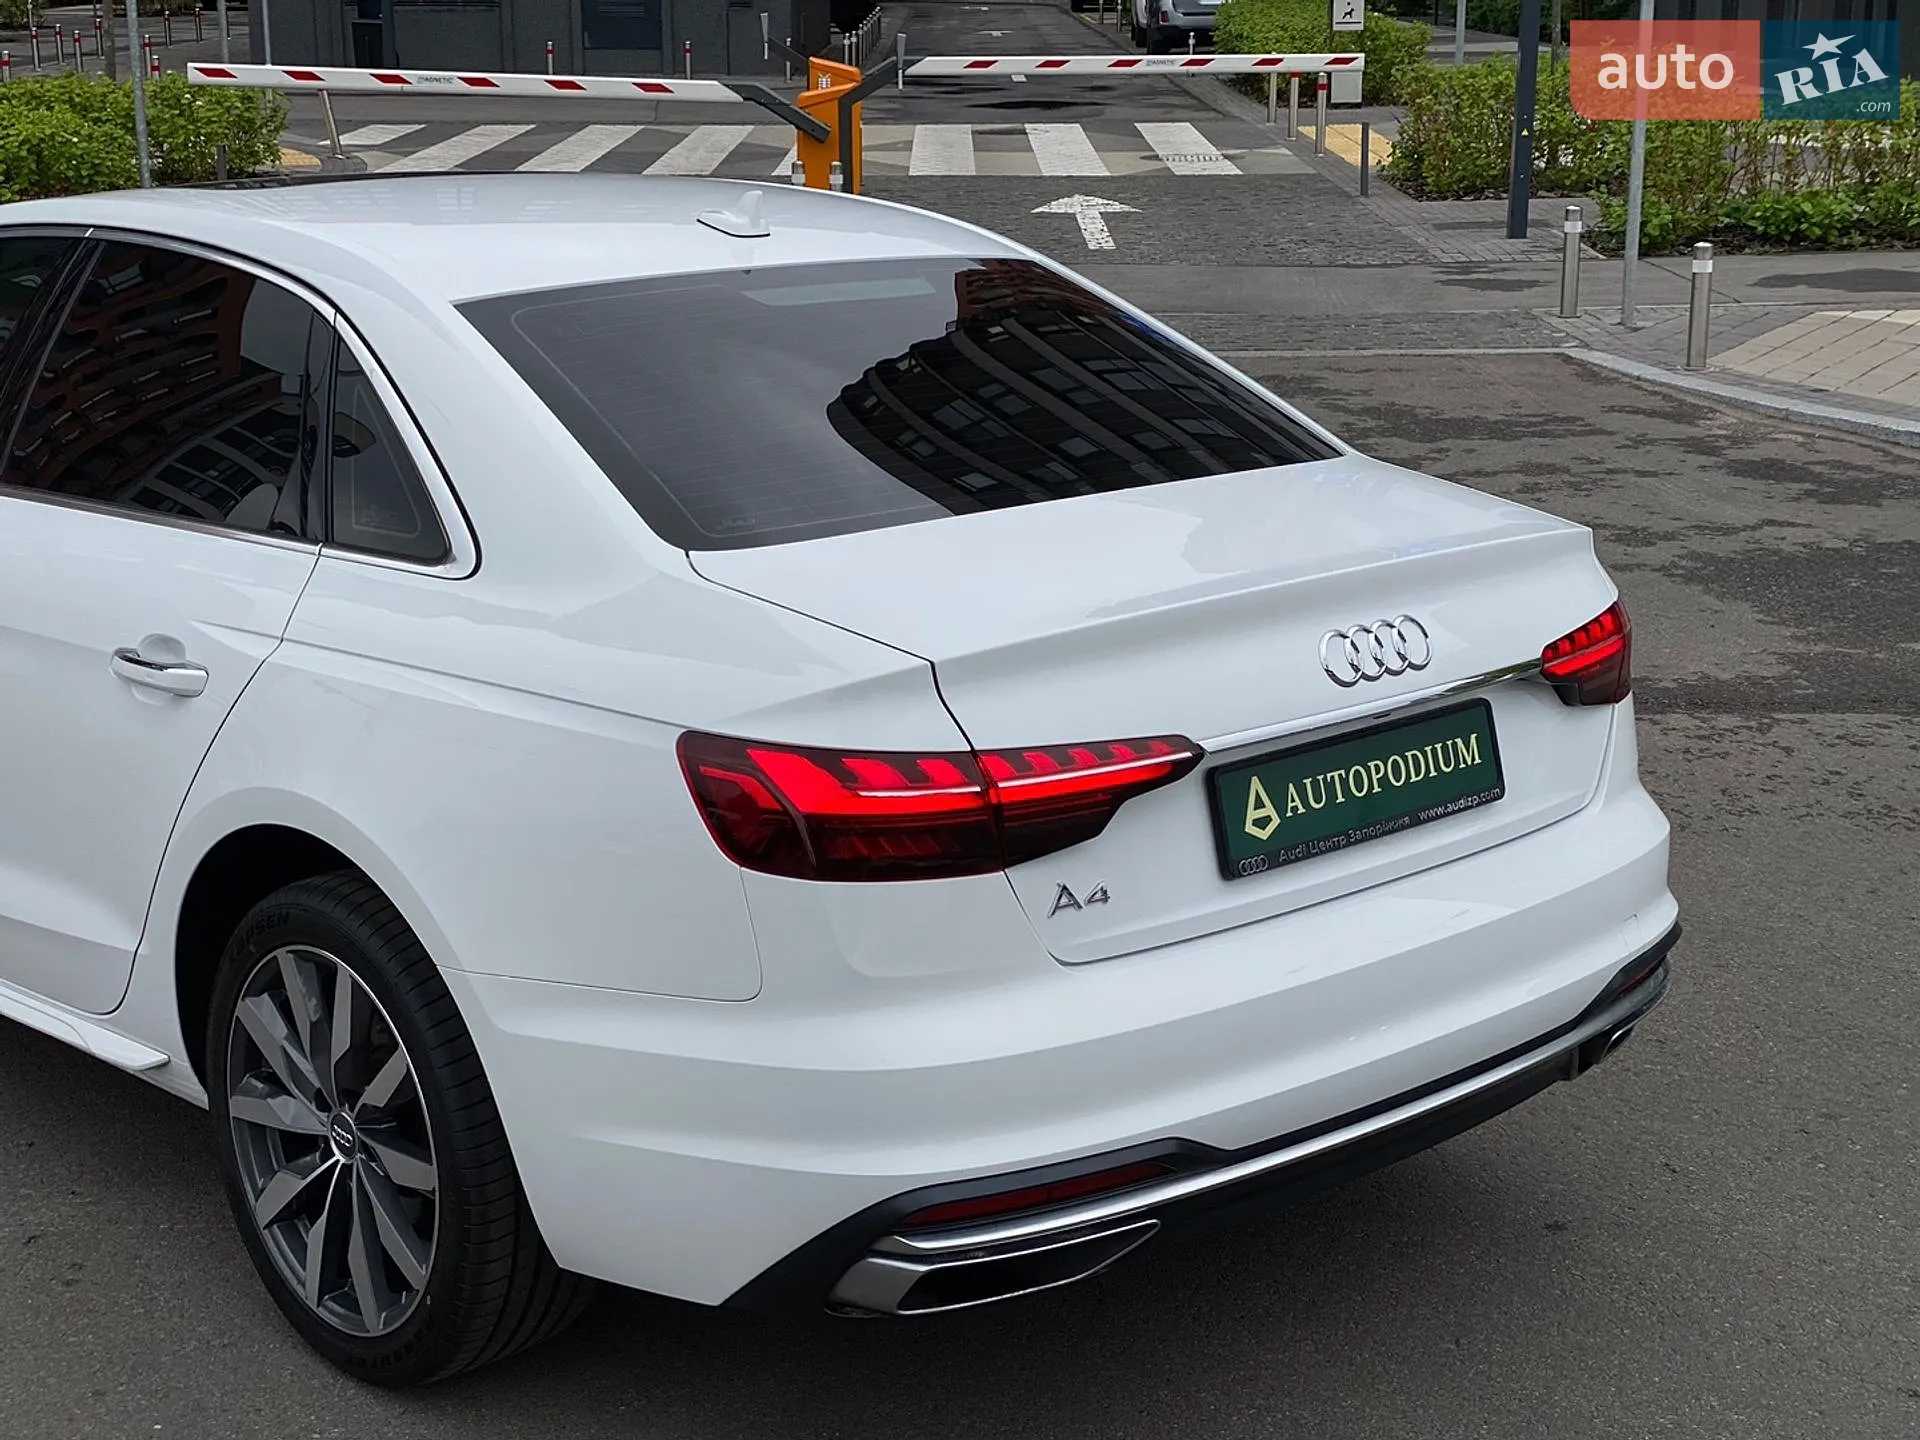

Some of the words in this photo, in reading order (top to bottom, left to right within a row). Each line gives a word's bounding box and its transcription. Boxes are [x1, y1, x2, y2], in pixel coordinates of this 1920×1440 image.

[1285, 733, 1482, 817] AUTOPODIUM
[1279, 844, 1307, 862] Audi
[1309, 834, 1347, 854] Центр
[1418, 787, 1501, 821] www.audizp.com
[1047, 880, 1110, 919] A4
